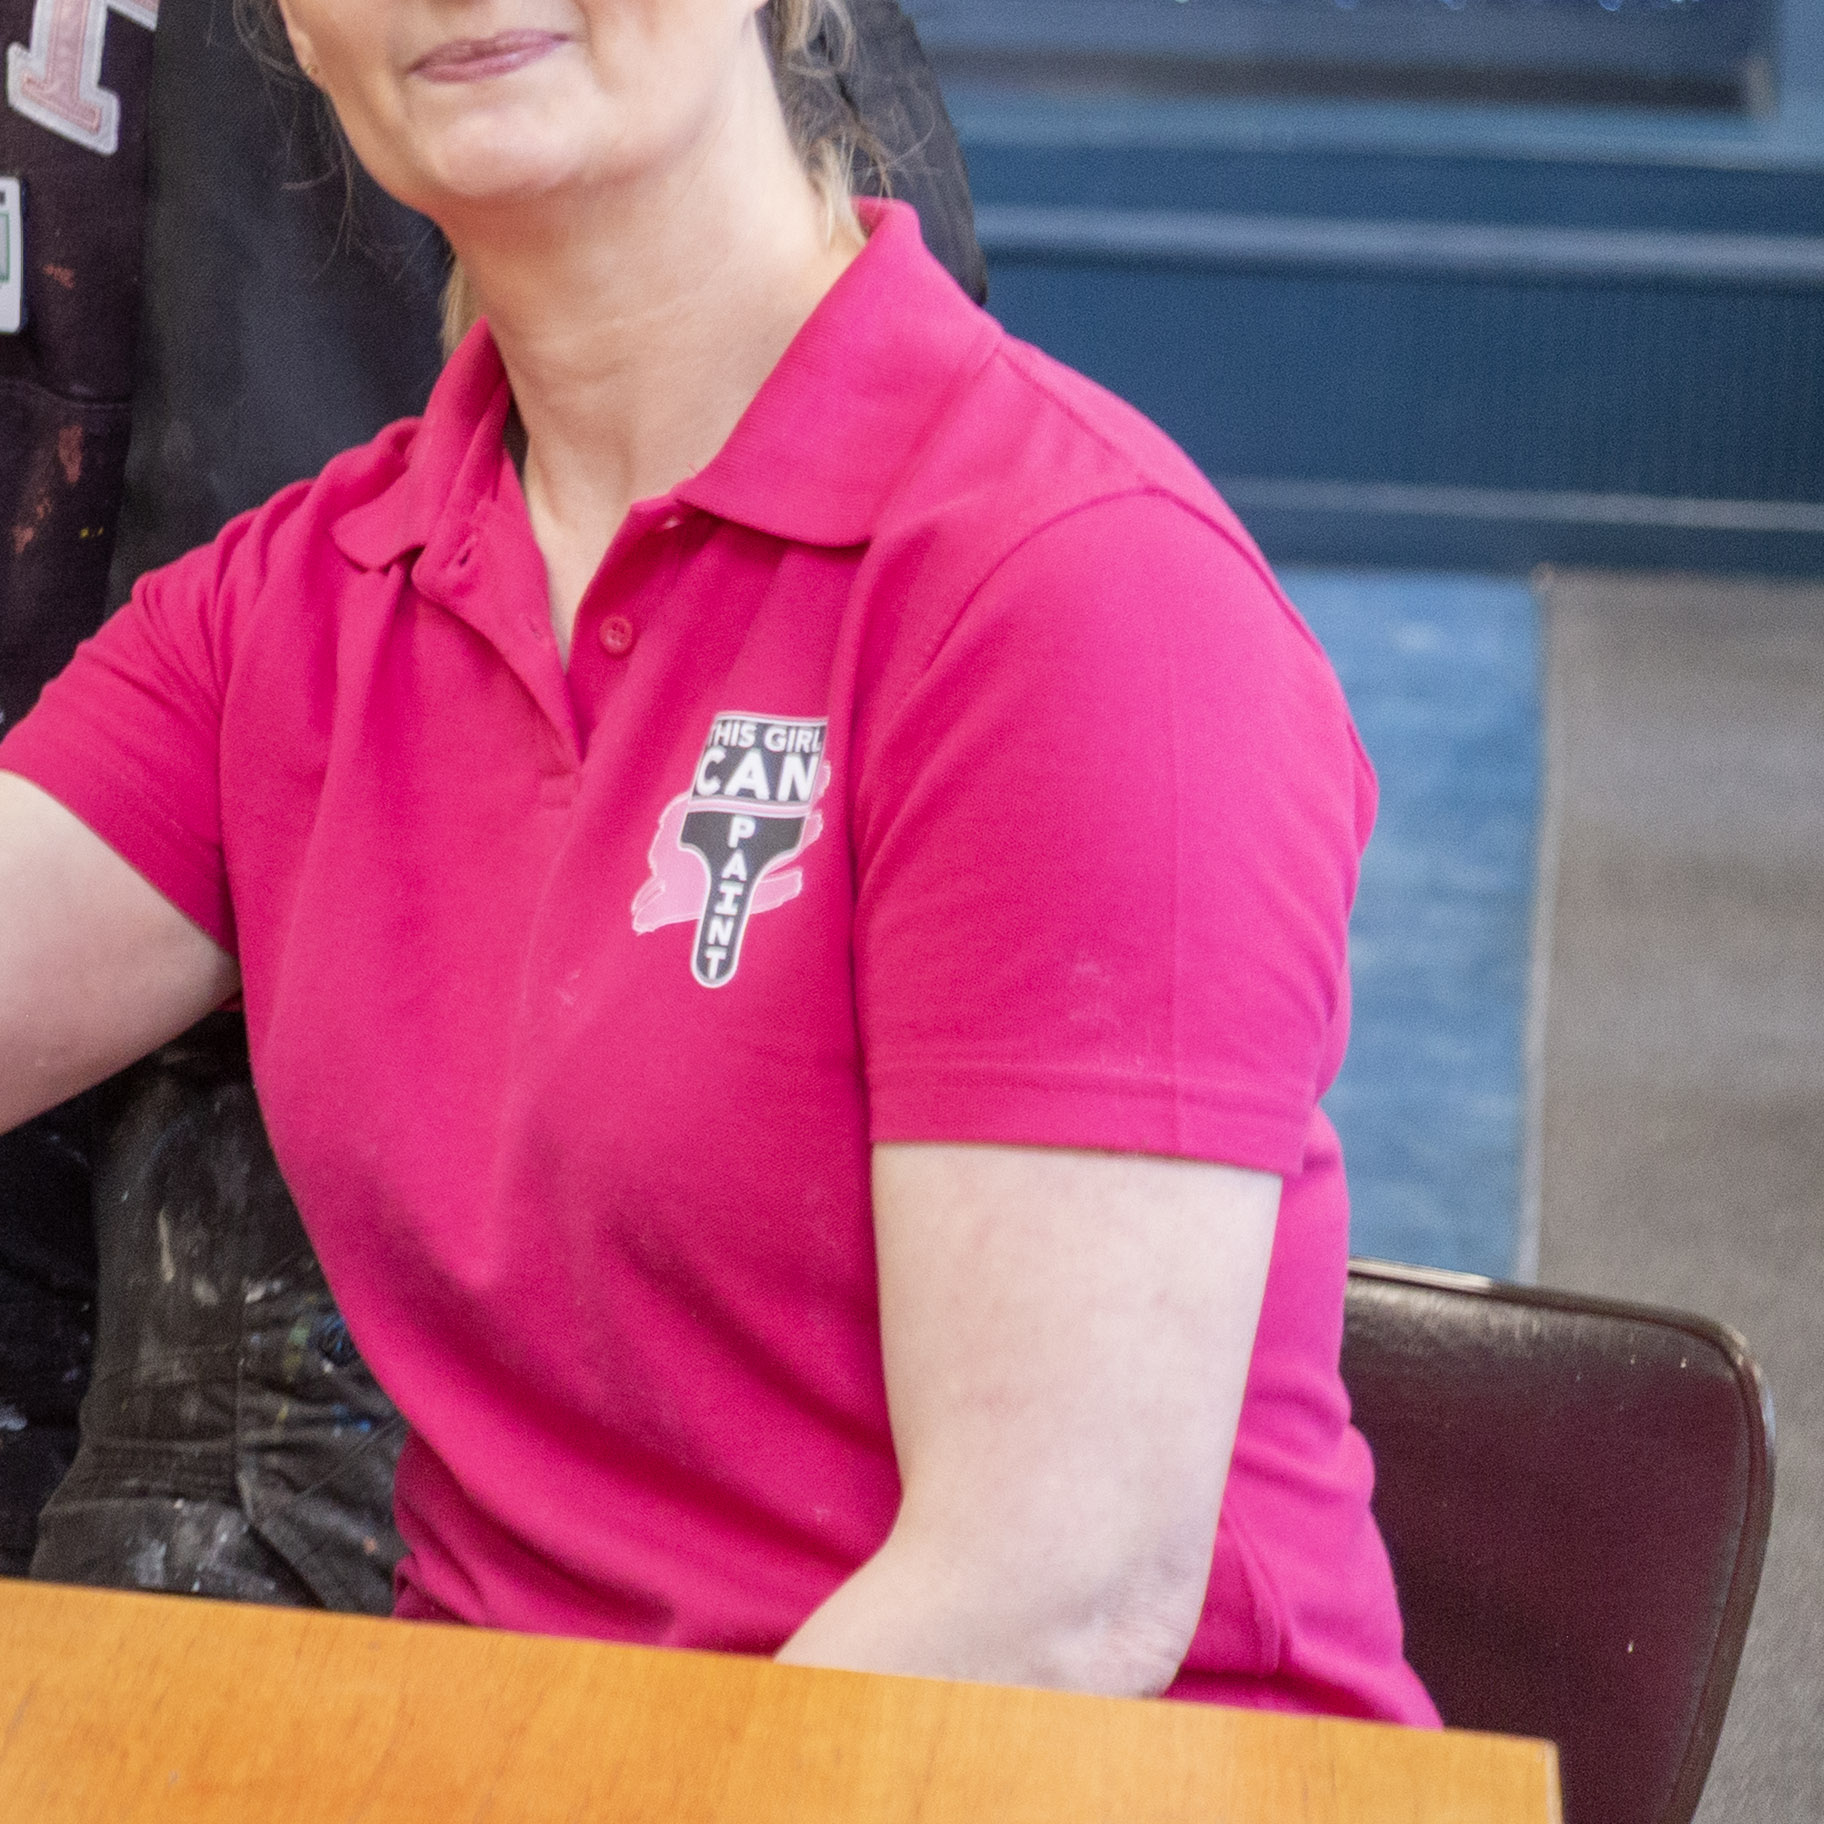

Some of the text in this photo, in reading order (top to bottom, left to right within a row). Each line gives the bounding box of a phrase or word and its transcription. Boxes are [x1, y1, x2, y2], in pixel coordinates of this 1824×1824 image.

[709, 722, 822, 753] HIS GIRL
[696, 746, 819, 801] CAN
[705, 816, 756, 978] PAINT
